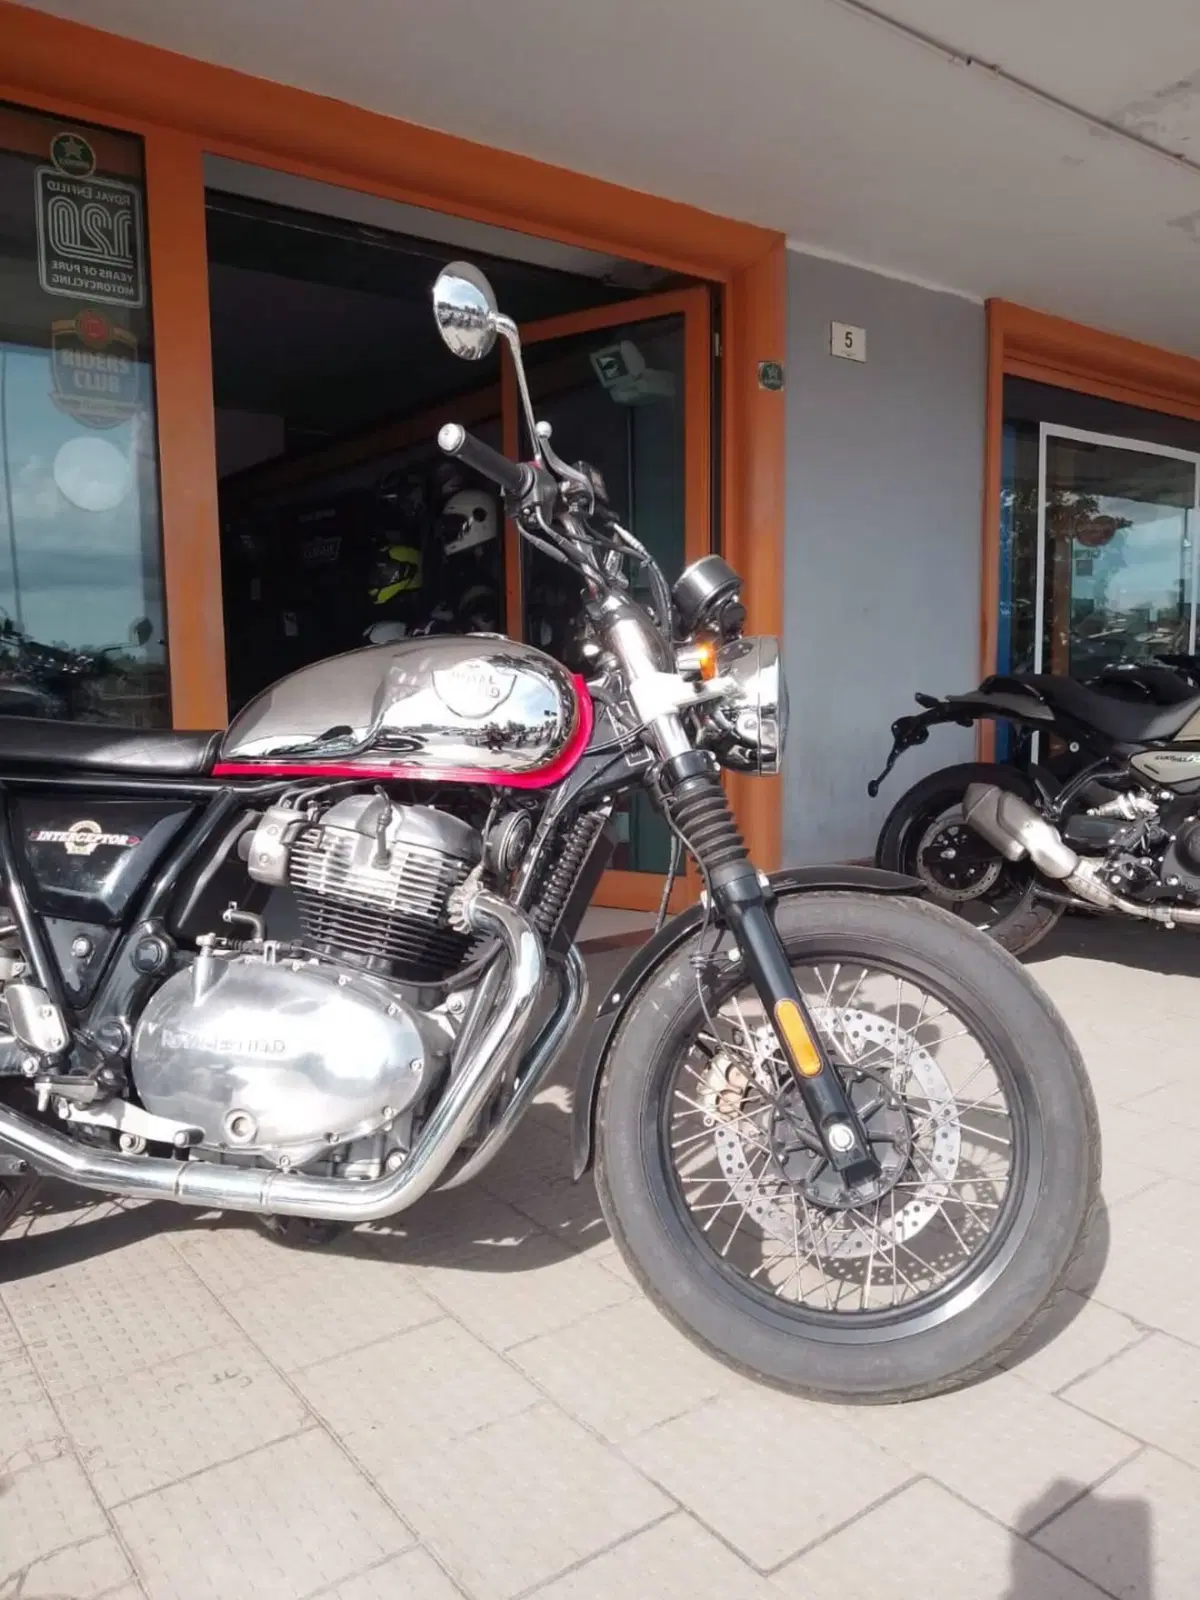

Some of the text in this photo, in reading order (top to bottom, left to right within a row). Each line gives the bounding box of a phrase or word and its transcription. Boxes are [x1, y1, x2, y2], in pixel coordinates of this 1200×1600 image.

[844, 331, 853, 348] 5
[452, 671, 496, 685] YAL
[36, 830, 129, 845] INTERCEPTOR
